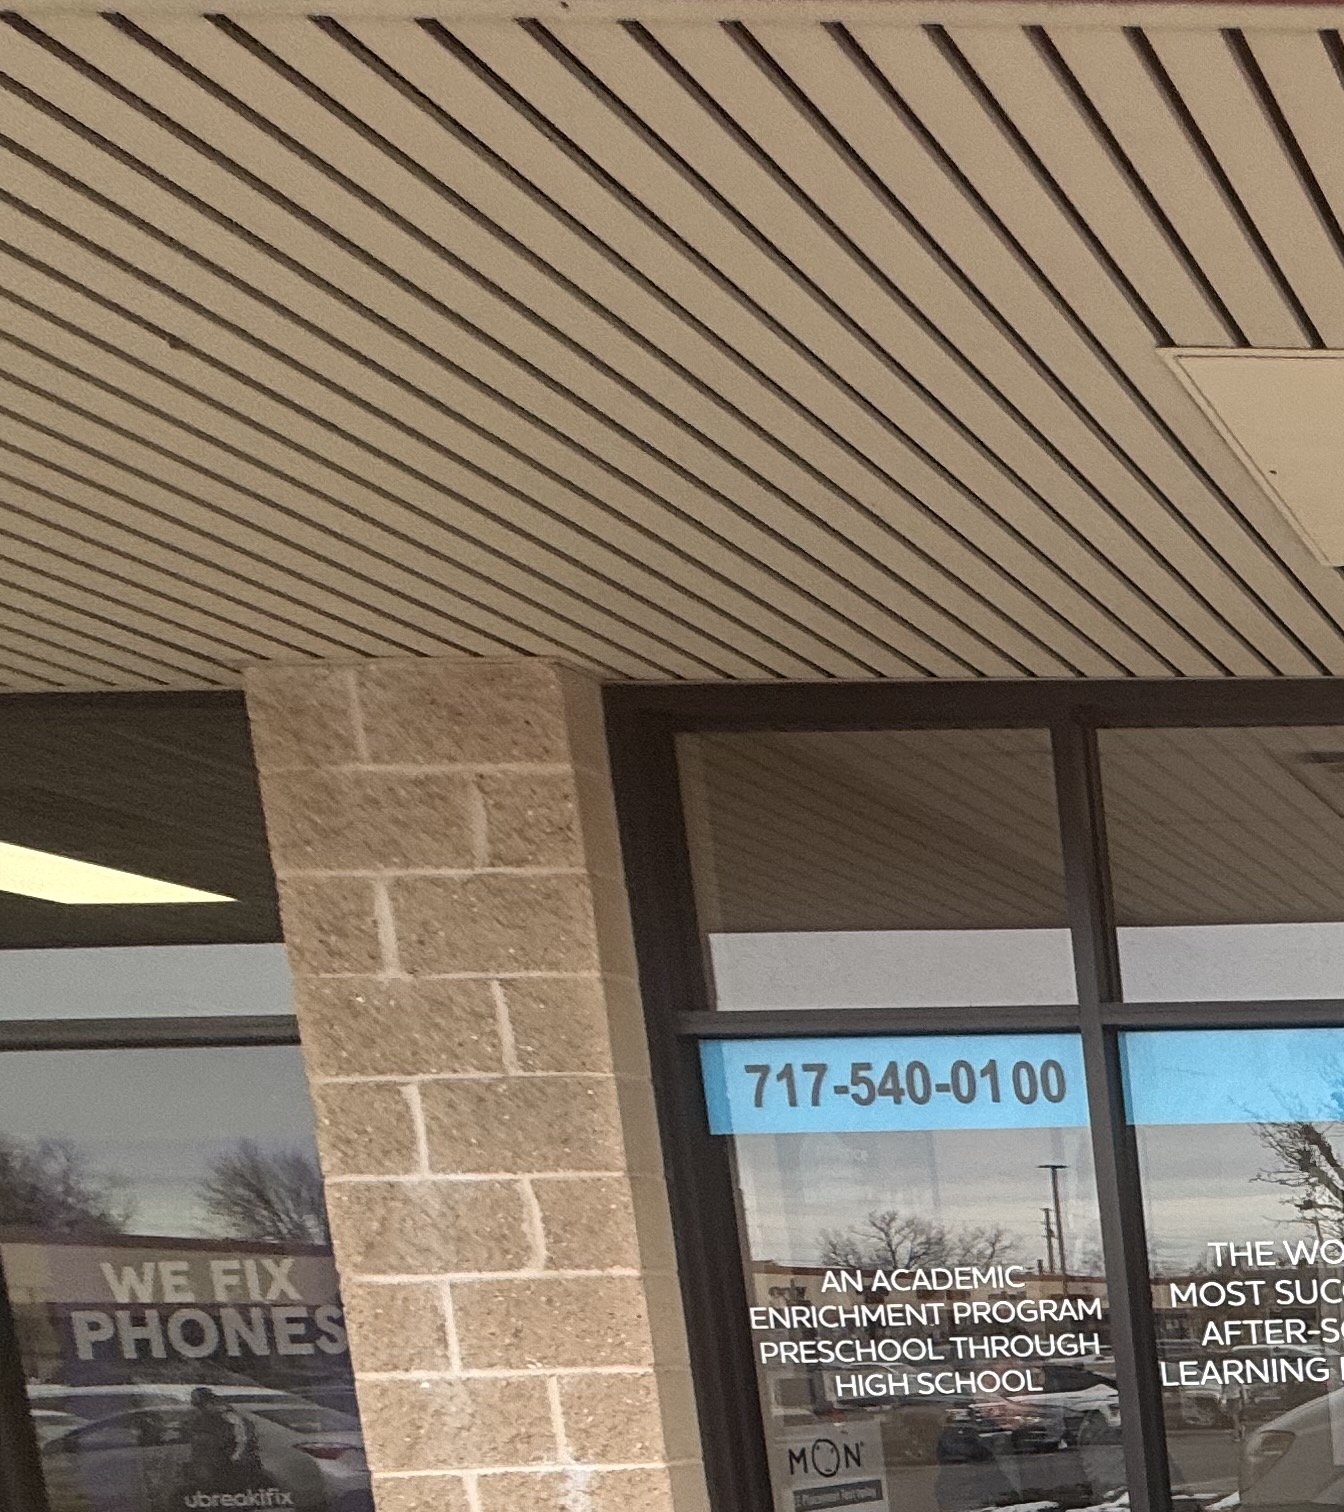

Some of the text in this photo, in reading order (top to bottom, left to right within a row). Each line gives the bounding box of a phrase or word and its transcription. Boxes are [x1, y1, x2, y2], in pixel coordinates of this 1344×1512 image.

[744, 1060, 1066, 1108] 717-540-0100
[1208, 1240, 1276, 1267] THE
[101, 1258, 302, 1303] WE FIX
[821, 1269, 864, 1293] AN
[871, 1265, 1025, 1292] ACADEMIC
[1170, 1280, 1266, 1308] MOST
[750, 1298, 1102, 1330] ENRICHMENT PROGRAM
[71, 1304, 349, 1360] PHONES
[759, 1332, 1101, 1364] PRESCHOOL THROUGH
[835, 1369, 1043, 1397] HIGH SCHOOL
[1160, 1356, 1330, 1387] LEARNING
[184, 1488, 295, 1509] ubreakifix
